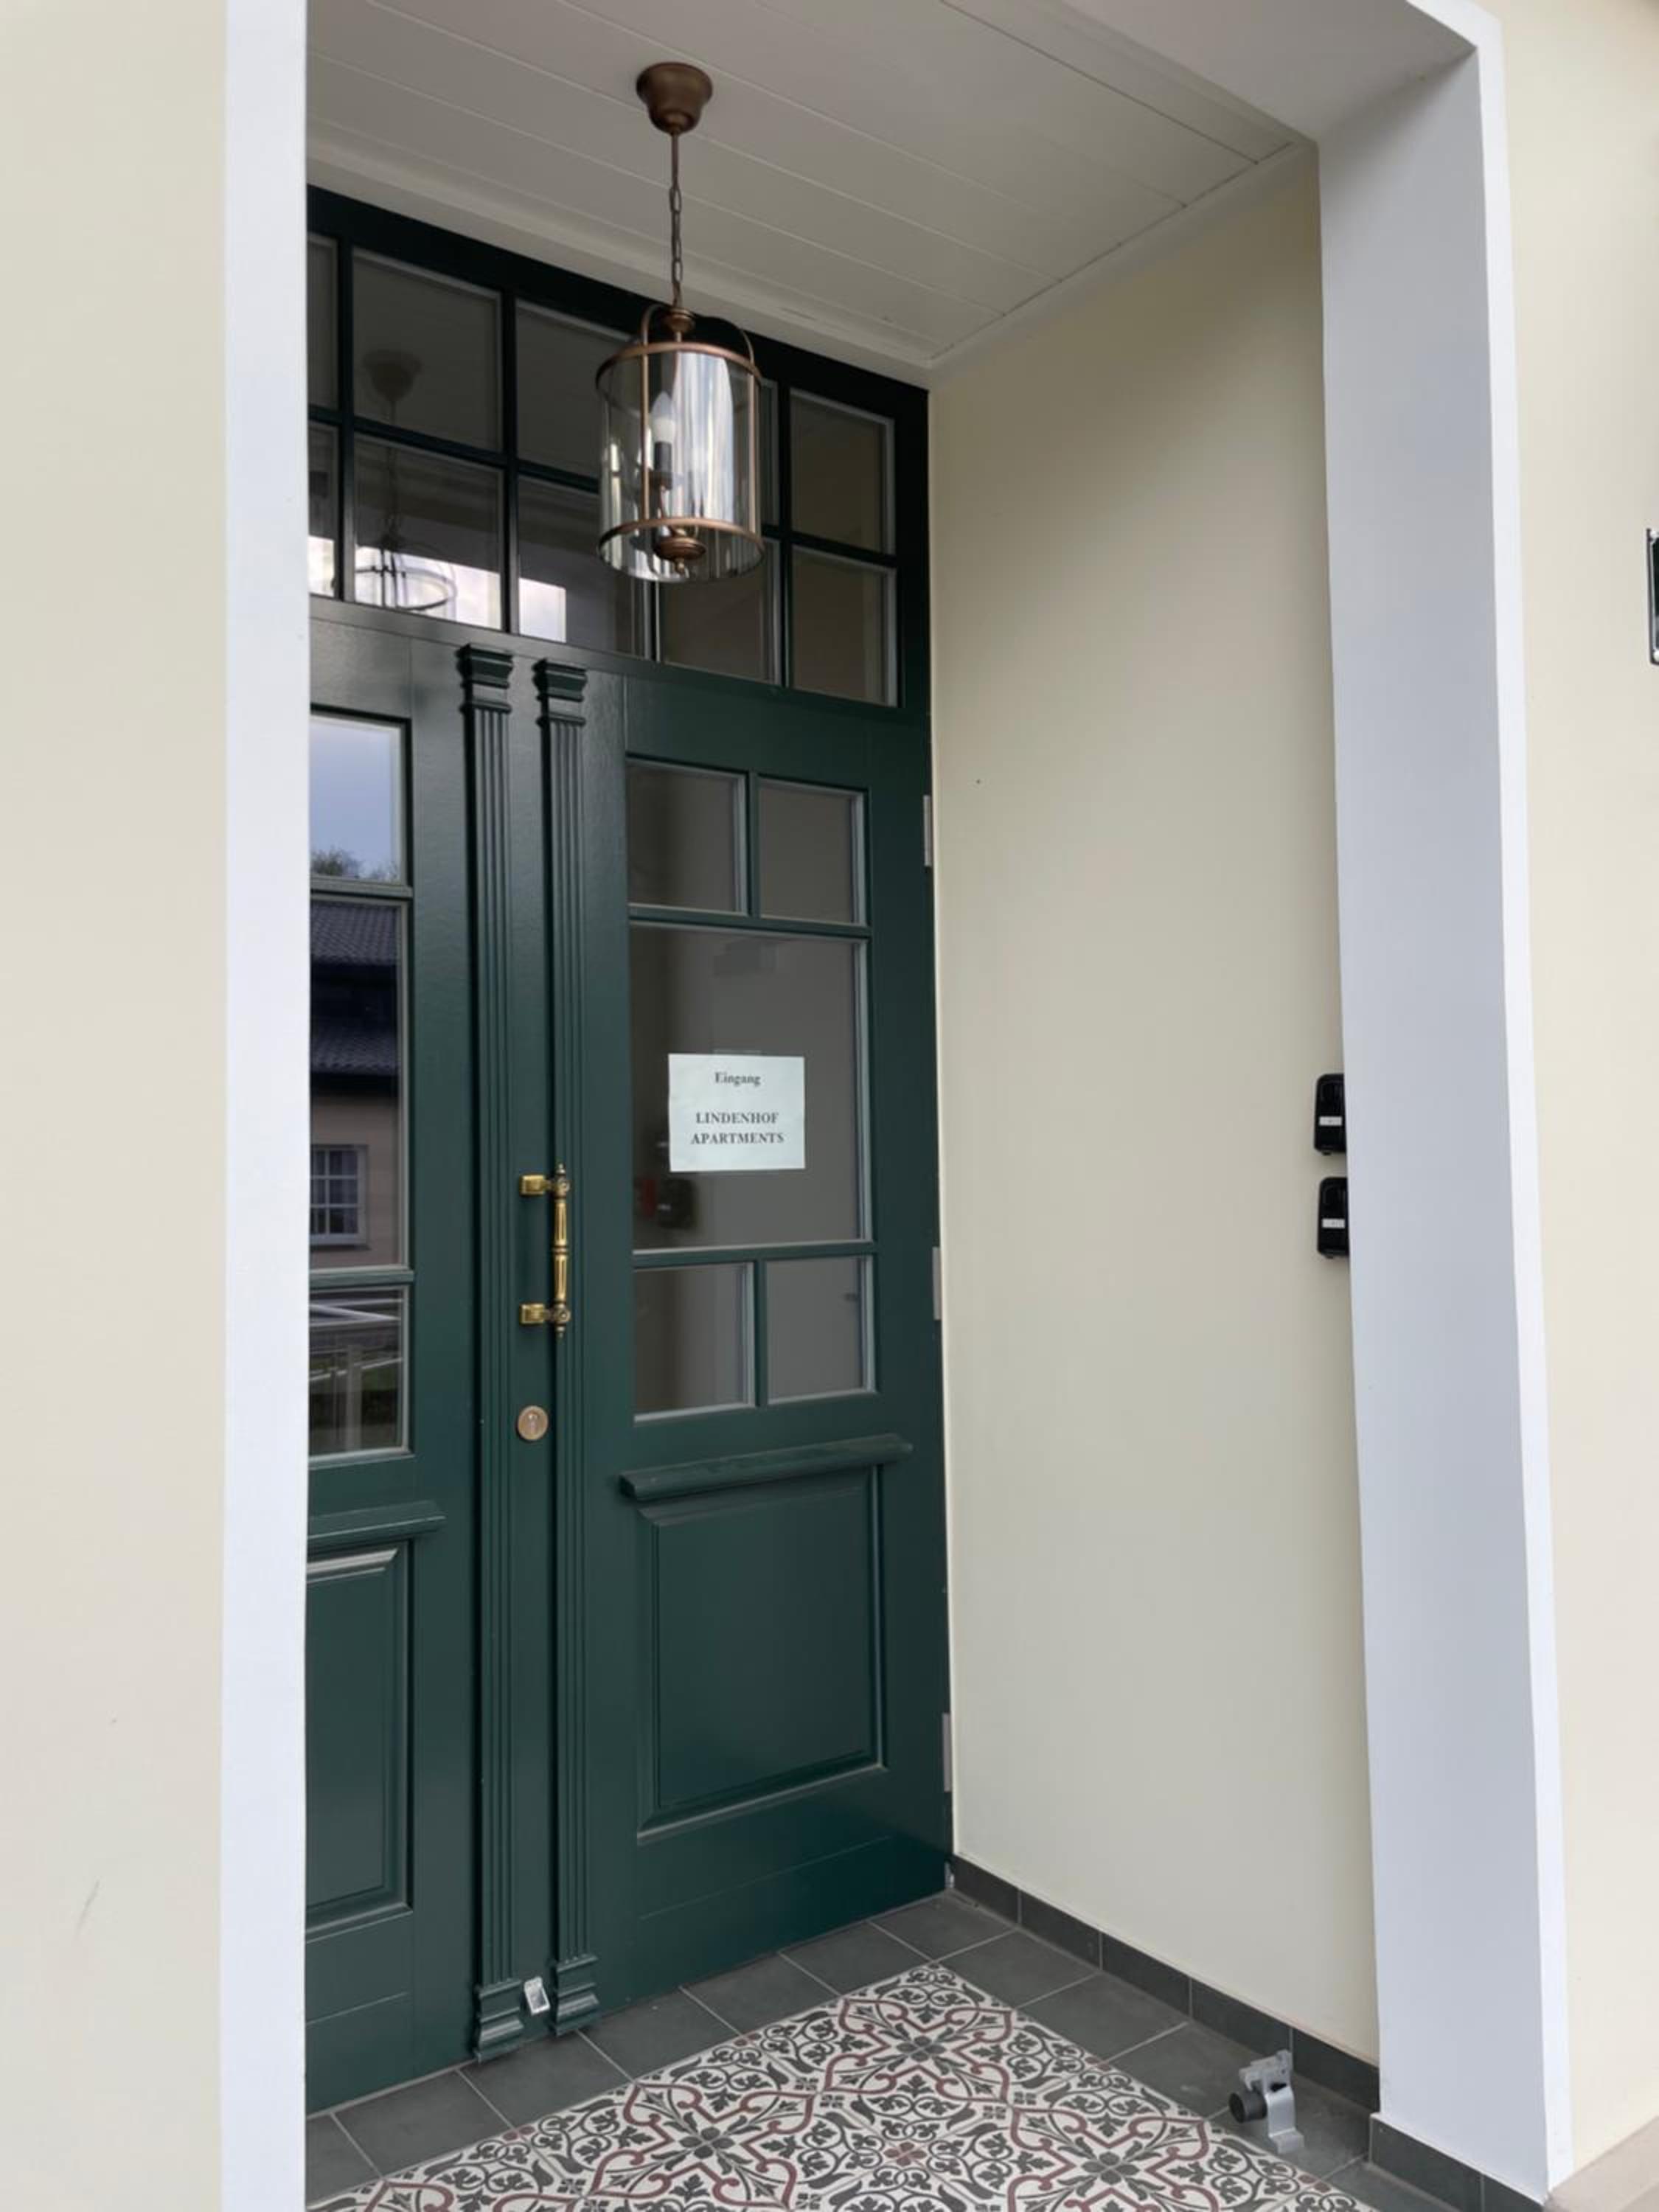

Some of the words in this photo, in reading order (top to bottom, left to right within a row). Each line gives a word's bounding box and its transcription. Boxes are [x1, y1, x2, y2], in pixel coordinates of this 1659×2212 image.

[714, 1072, 760, 1086] Eingang
[695, 1112, 779, 1124] LINDENHOF
[690, 1133, 784, 1144] APARTMENTS
